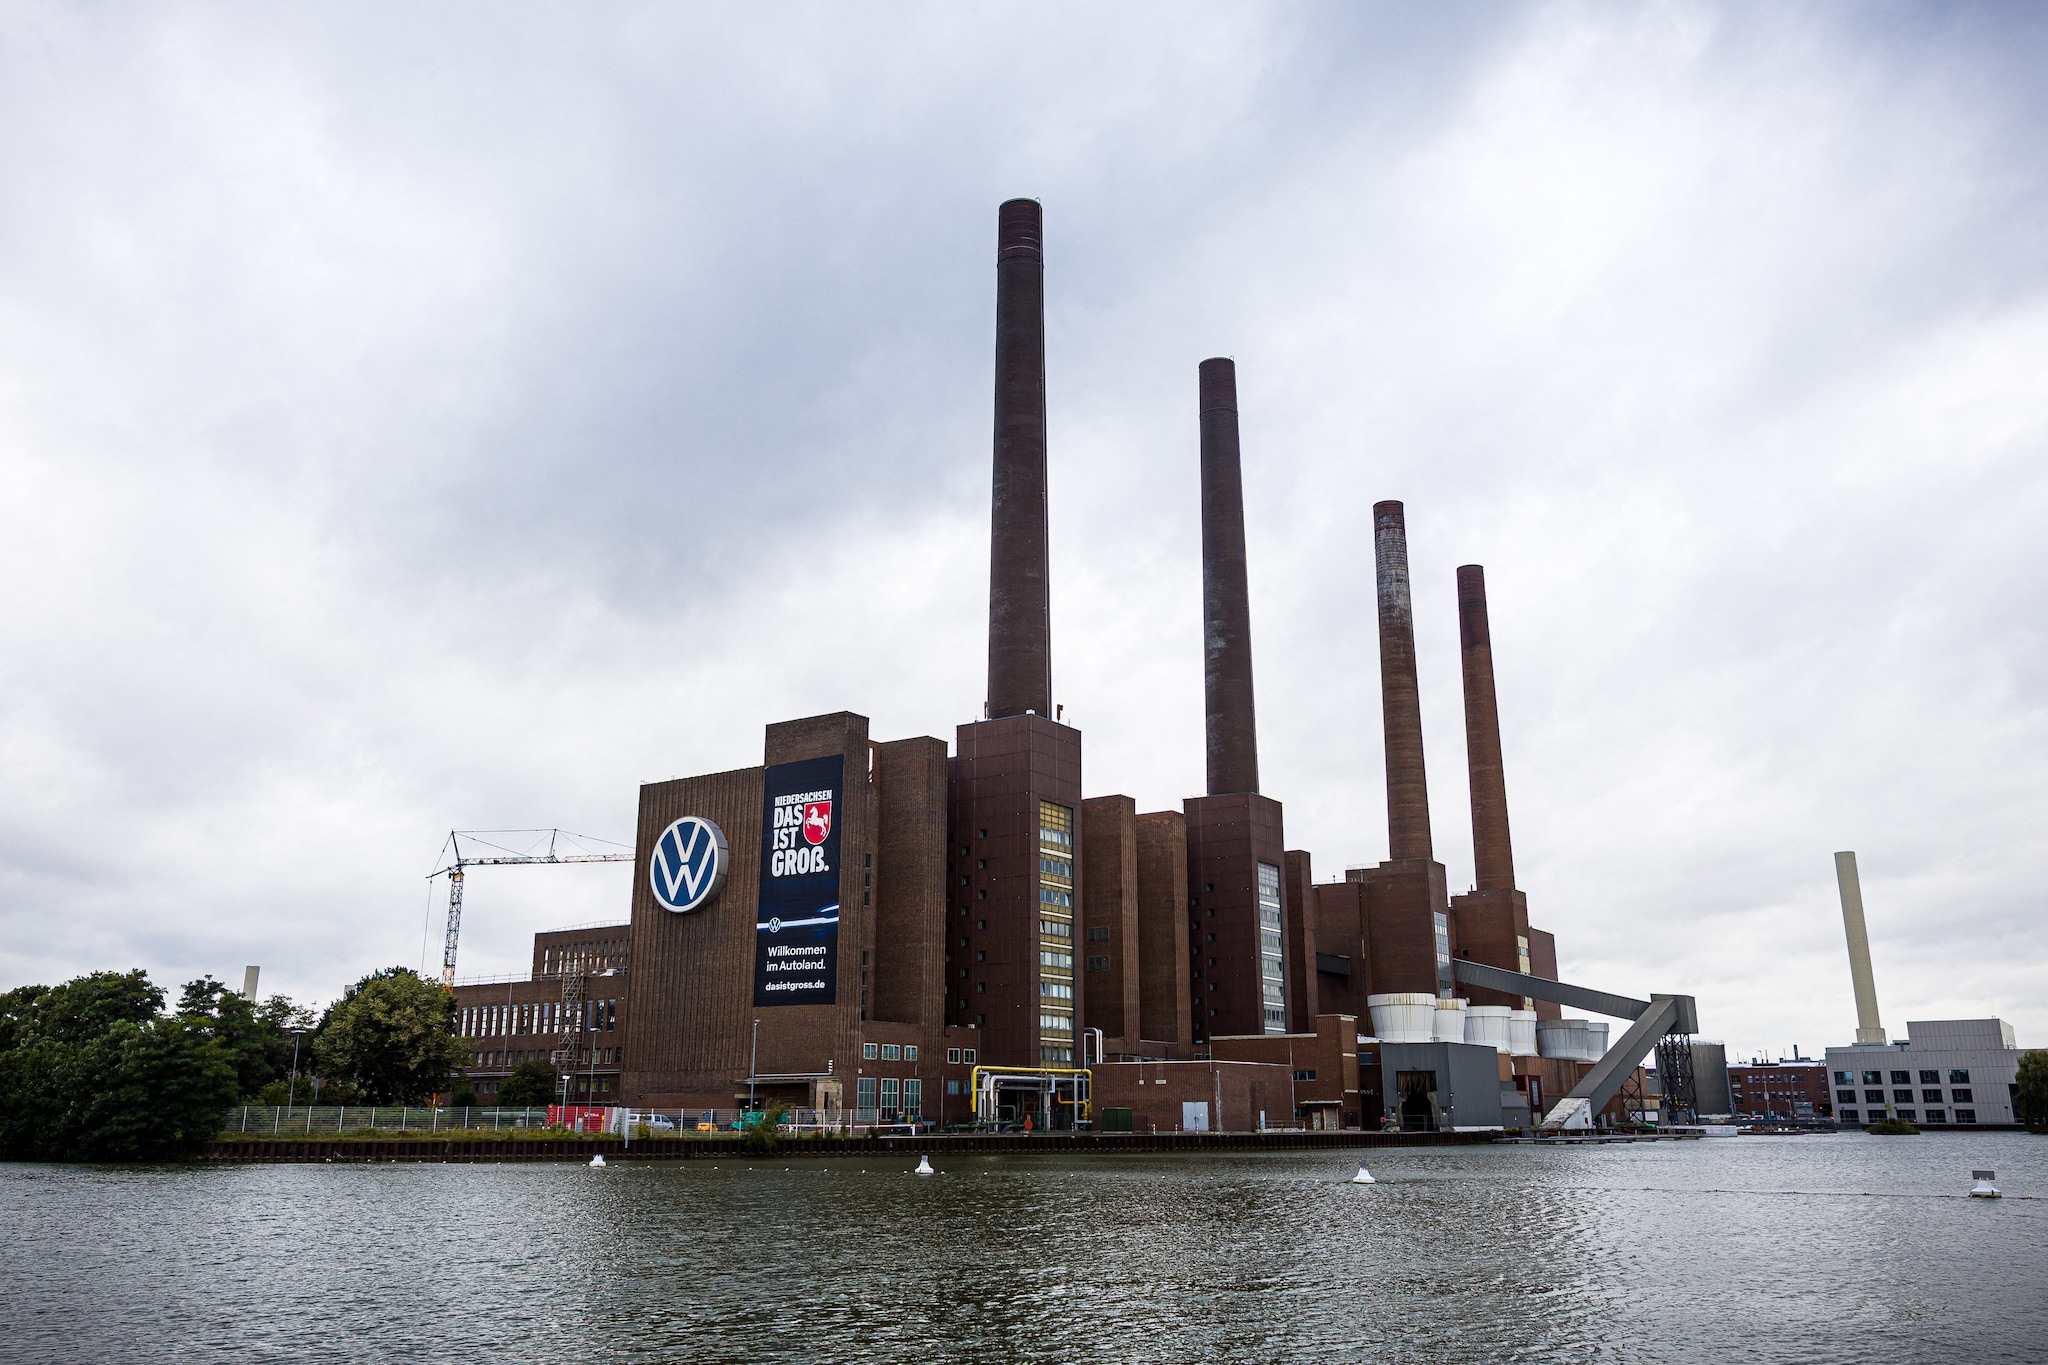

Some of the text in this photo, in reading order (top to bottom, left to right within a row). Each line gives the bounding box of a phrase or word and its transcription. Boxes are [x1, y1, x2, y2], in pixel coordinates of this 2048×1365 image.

[774, 789, 832, 807] NIEDERSACHSEN
[773, 804, 803, 828] DAS
[772, 826, 799, 850] IST
[652, 817, 717, 909] VW
[767, 945, 826, 957] Willkommen
[766, 958, 826, 972] im Autoland.
[765, 979, 826, 991] dasistgross.de
